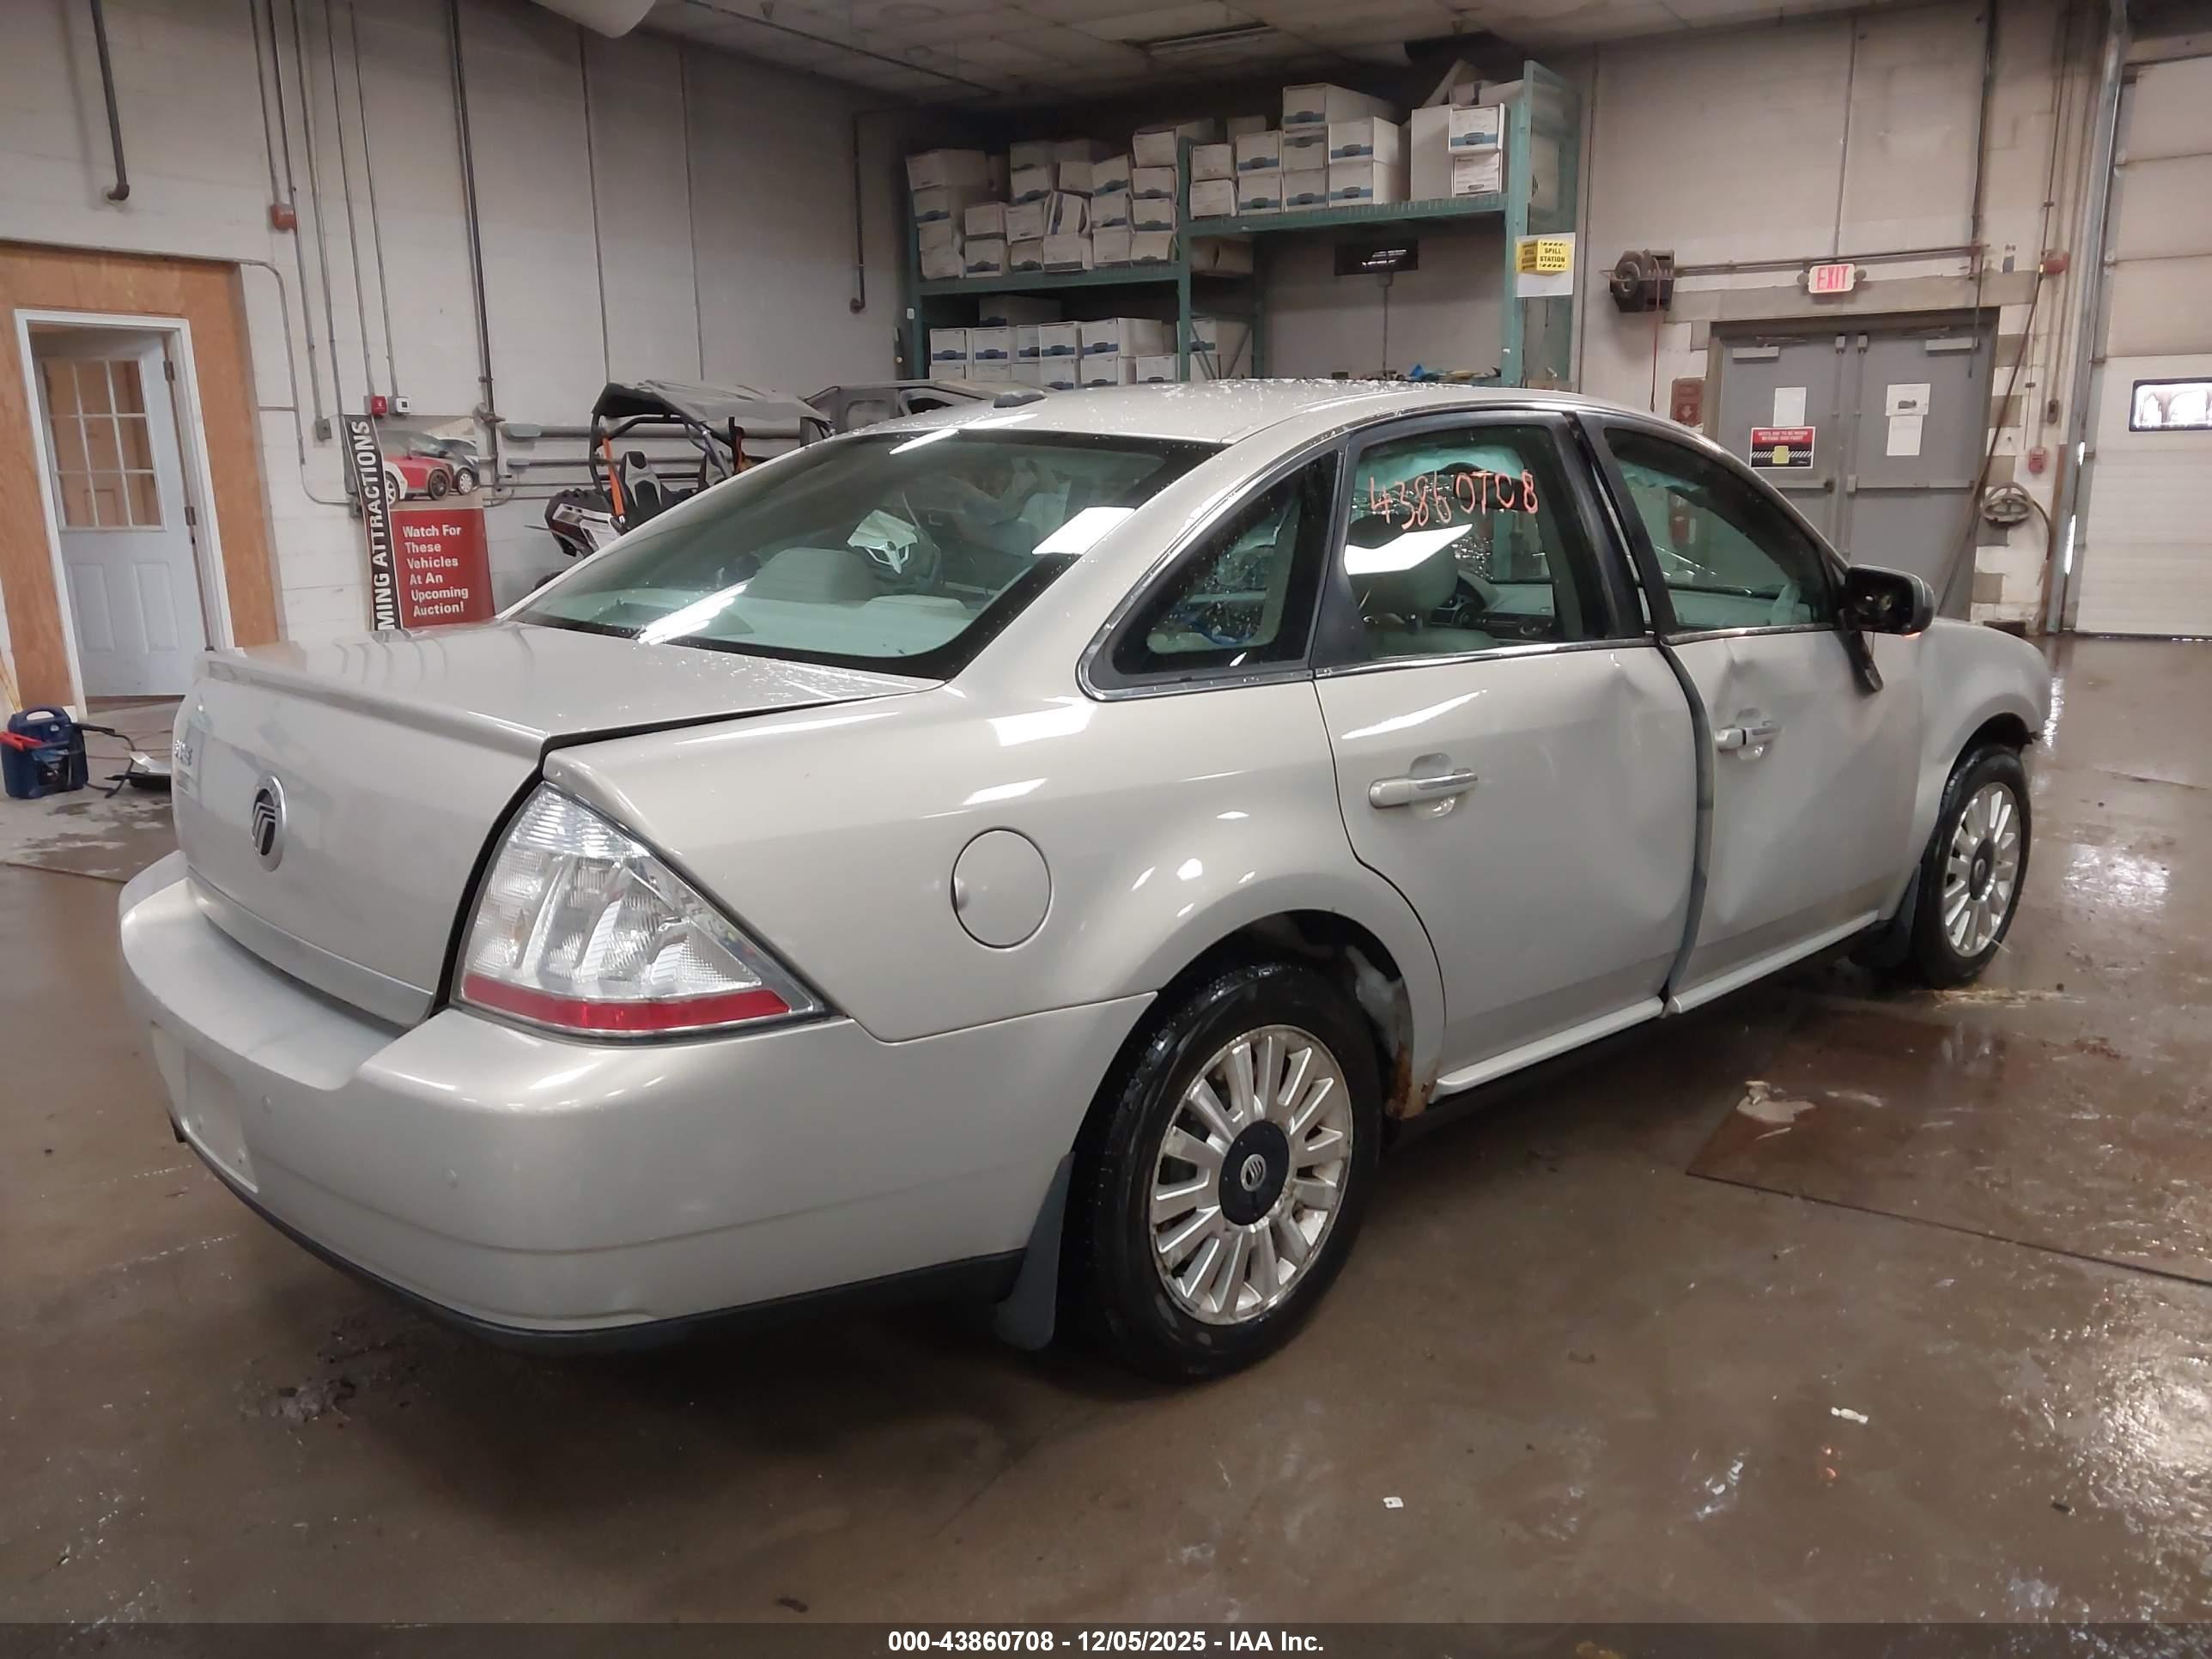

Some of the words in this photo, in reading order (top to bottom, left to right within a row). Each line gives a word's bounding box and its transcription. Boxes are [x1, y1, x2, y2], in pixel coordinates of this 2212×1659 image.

[1817, 266, 1849, 289] EXIT
[350, 421, 388, 567] ATTRACTIONS
[403, 526, 439, 538] Watch
[442, 524, 461, 536] For
[404, 541, 441, 553] These
[407, 556, 459, 568] Vehicles
[410, 574, 422, 585] At
[425, 572, 443, 584] An
[411, 586, 468, 603] Upcoming
[413, 601, 464, 617] Auction!
